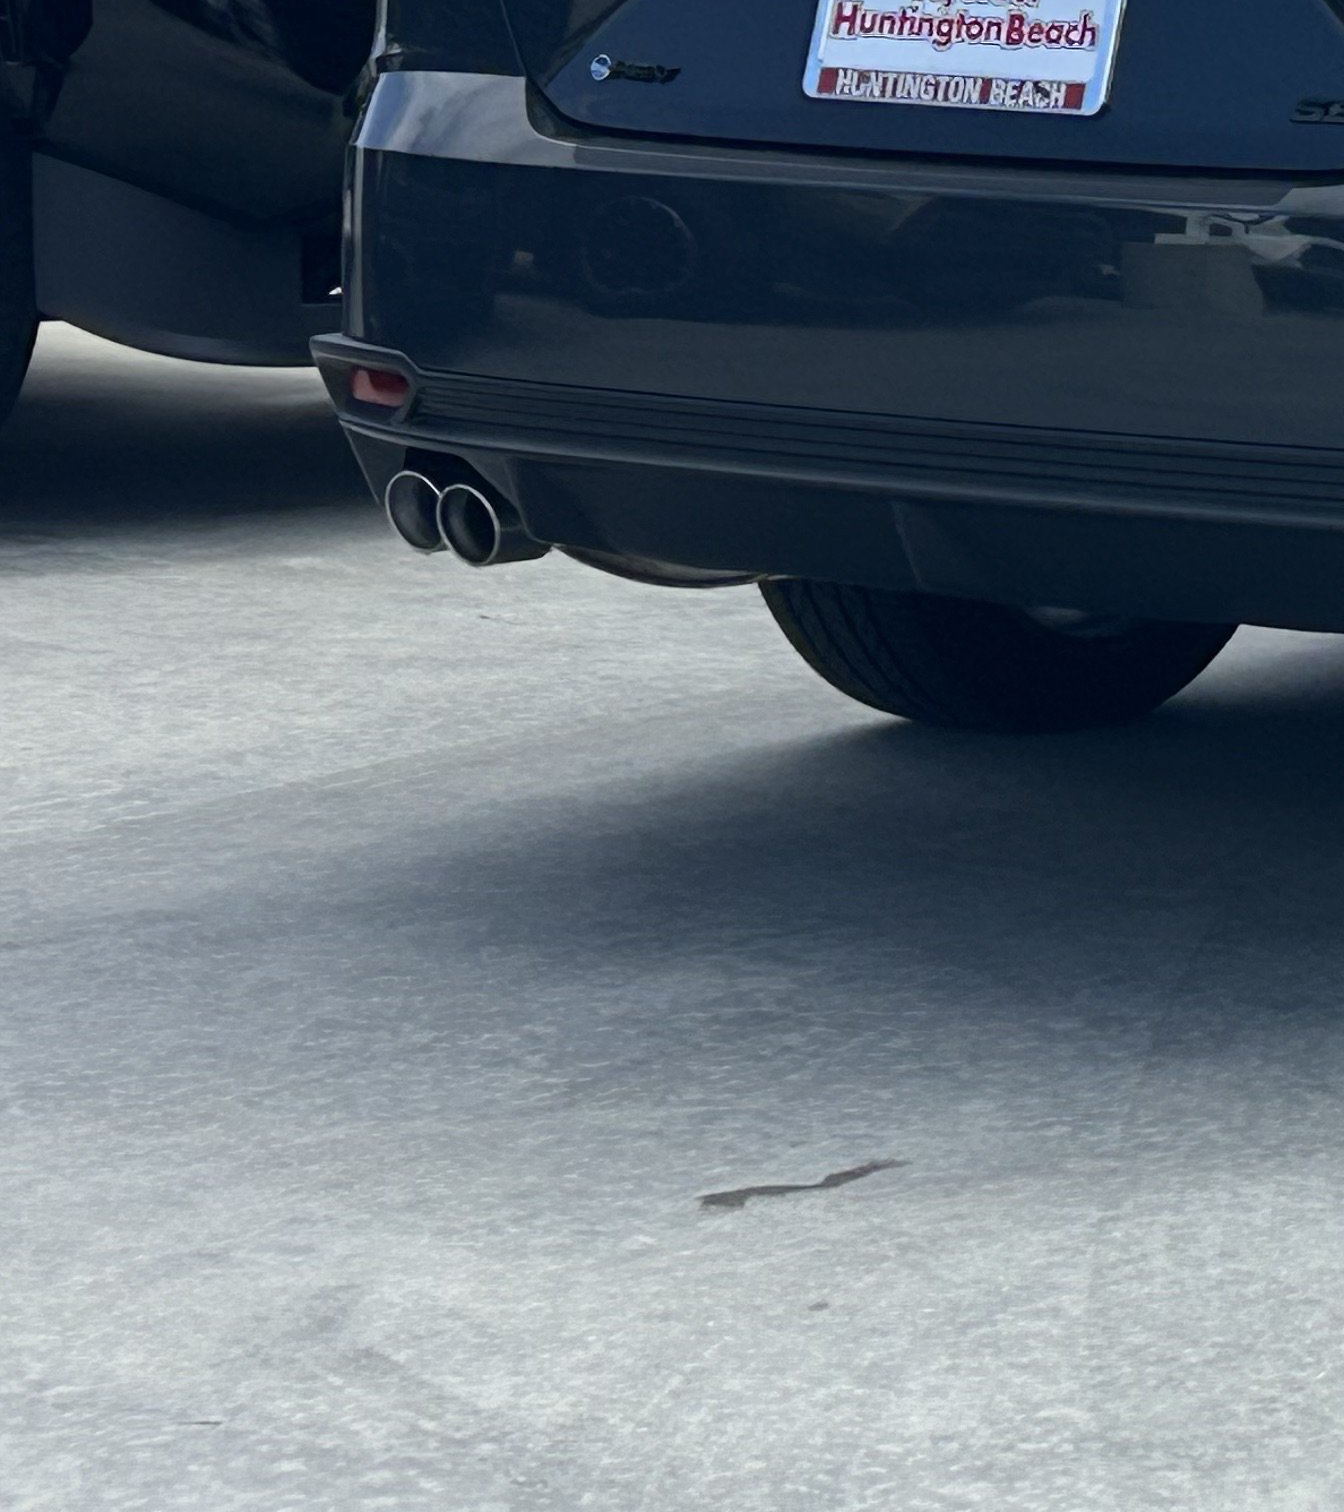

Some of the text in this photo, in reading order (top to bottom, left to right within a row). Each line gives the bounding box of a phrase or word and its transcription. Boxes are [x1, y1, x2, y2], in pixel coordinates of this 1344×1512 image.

[833, 0, 1097, 49] Huntington Beach
[834, 68, 982, 104] HUNTINGTON
